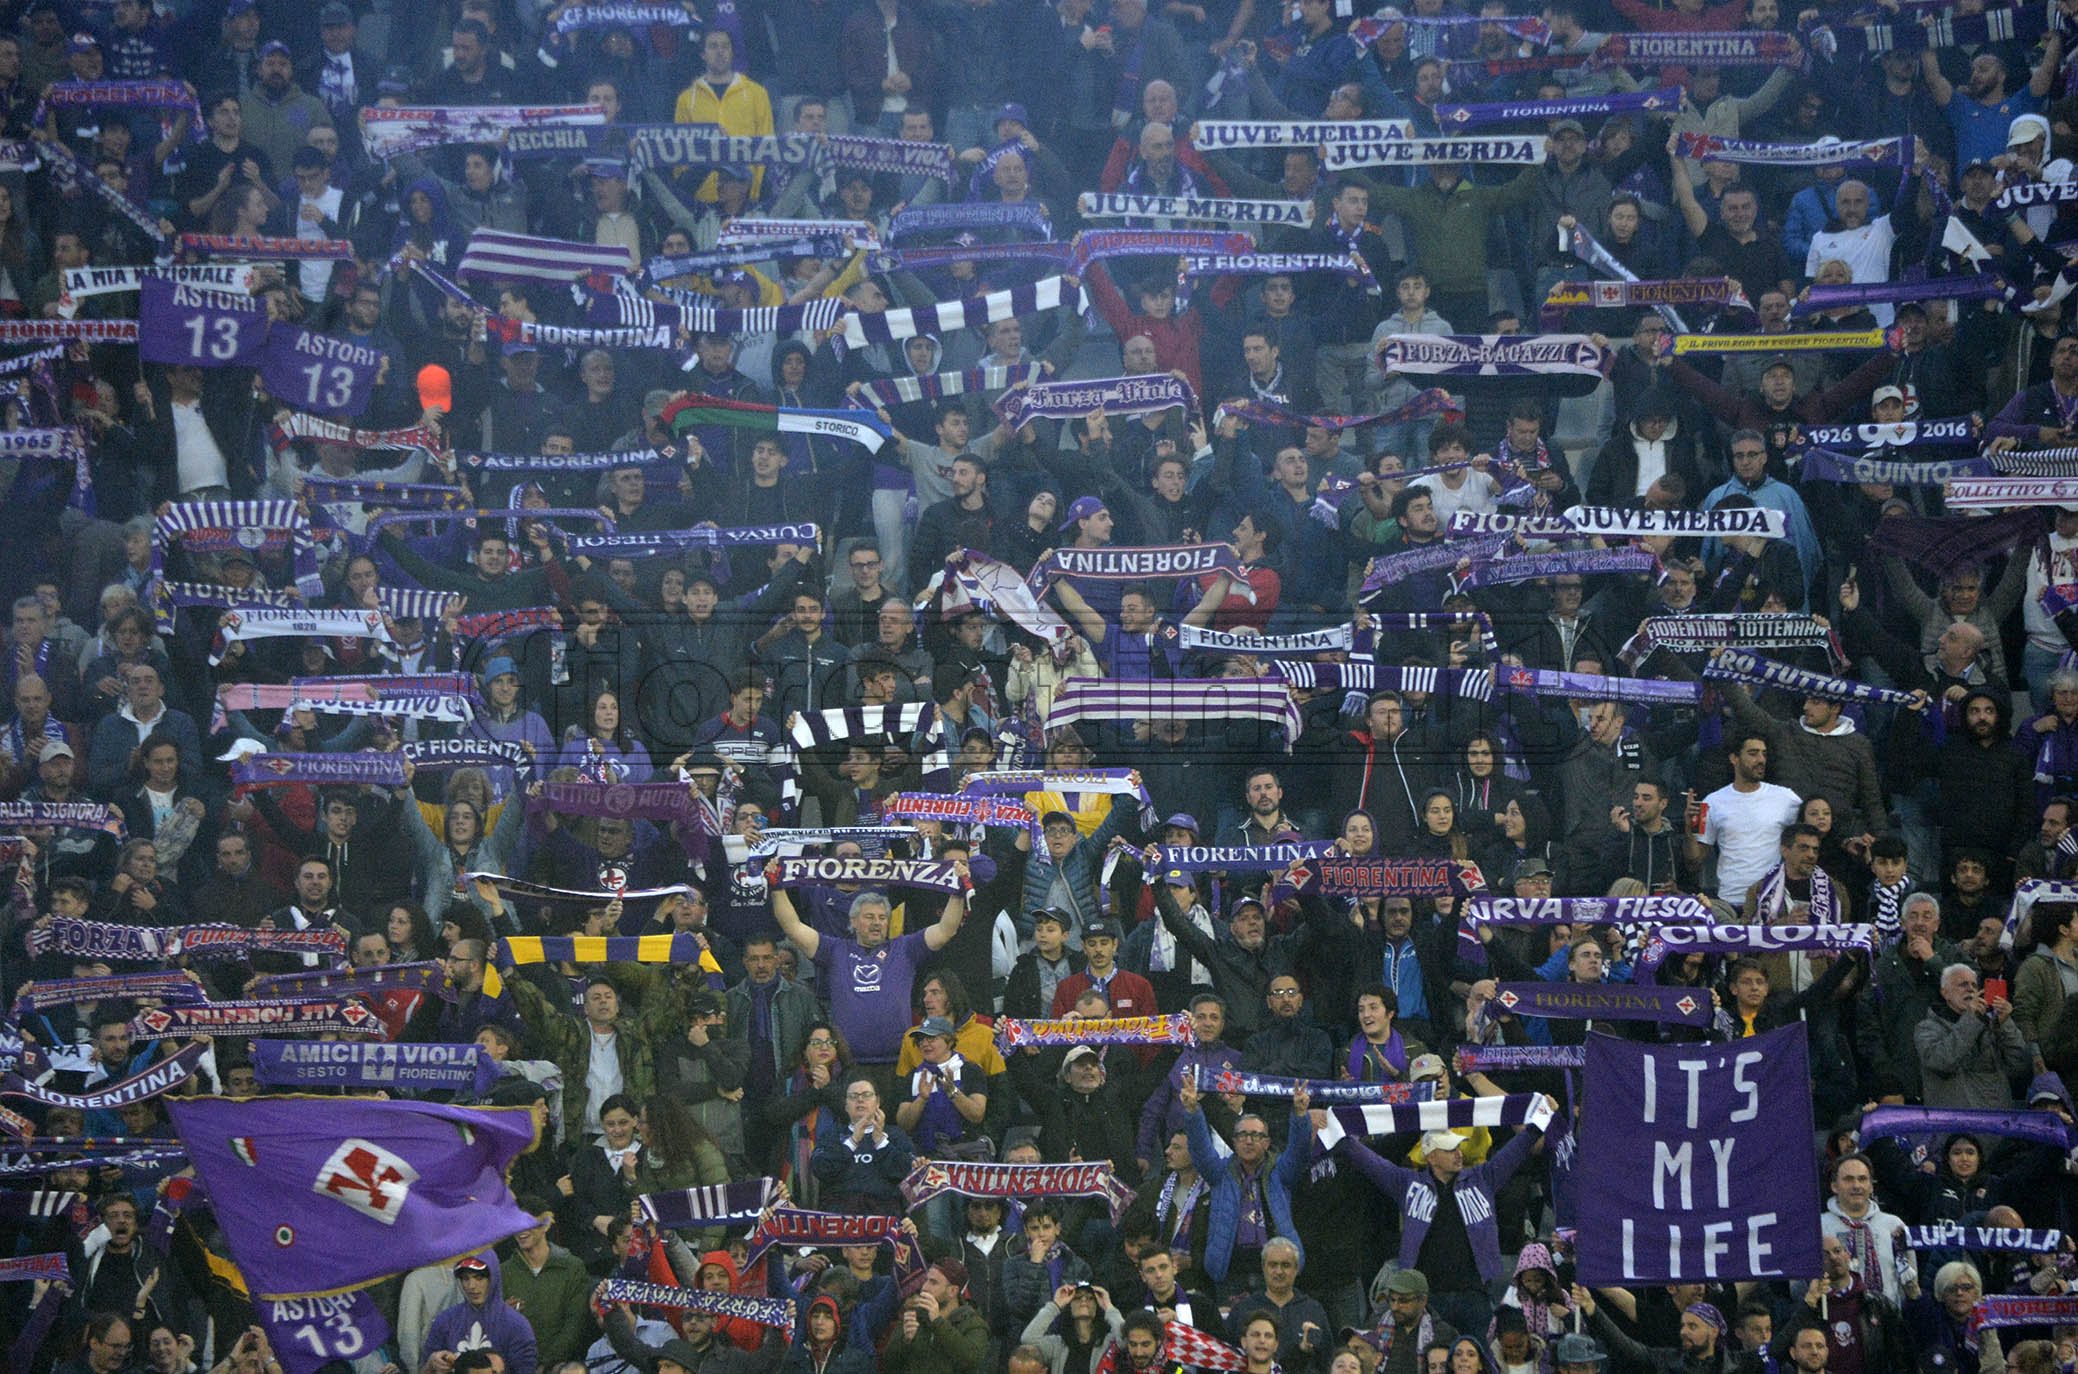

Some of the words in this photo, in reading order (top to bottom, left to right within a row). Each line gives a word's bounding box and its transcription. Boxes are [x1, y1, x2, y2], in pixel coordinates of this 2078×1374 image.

[588, 5, 689, 24] FIORENTINA
[1629, 37, 1756, 58] FIORENTINA
[1502, 102, 1610, 119] FIORENTINA
[1200, 125, 1282, 147] JUVE
[1290, 122, 1403, 147] MERDA
[656, 135, 806, 167] ULTRAS
[1331, 145, 1412, 165] JUVE
[1422, 142, 1534, 162] MERDA
[1997, 181, 2078, 208] JUVE
[1088, 192, 1177, 215] JUVE
[1187, 198, 1305, 221] MERDA
[1214, 253, 1360, 272] FIORENTINA
[92, 272, 127, 288] MIA
[0, 323, 138, 338] FIORENTINA
[184, 314, 239, 360] 13
[521, 323, 672, 349] FIORENTINA
[295, 332, 376, 369] ASTORI
[303, 363, 354, 408] 13
[815, 420, 859, 437] STORICO
[1808, 429, 1853, 444] 1926
[1922, 421, 1966, 438] 2016
[3, 434, 54, 450] 1965
[485, 455, 520, 468] ACF
[527, 449, 658, 468] FIORENTINA
[1853, 460, 1954, 485] QUINTO
[1577, 506, 1656, 531] JUVE
[1661, 506, 1770, 534] MERDA
[1057, 547, 1217, 573] FIORENTINA
[246, 606, 362, 624] FIORENTINA
[1199, 630, 1333, 649] FIORENTINA
[1645, 621, 1728, 639] FIORENTINA
[1764, 661, 1848, 696] TUTTO
[716, 747, 766, 759] OPEL
[298, 760, 402, 777] FIORENTINA
[983, 772, 1107, 787] FIORENTINA
[0, 803, 34, 819] ALLA
[1167, 844, 1318, 864] FIORENTINA
[783, 857, 959, 892] FIORENZA
[1320, 866, 1449, 888] FIORENTINA
[1535, 993, 1662, 1011] FIORENTINA
[173, 1006, 295, 1025] FIORENTINA
[280, 1044, 360, 1065] AMICI
[402, 1045, 478, 1067] VIOLA
[24, 1059, 186, 1109] FIORENTINA
[296, 1067, 347, 1078] SESTO
[400, 1067, 476, 1081] FIORENTINO
[1643, 1052, 1763, 1129] IT'S
[854, 1153, 874, 1165] YO
[1652, 1137, 1736, 1210] MY
[1622, 1212, 1783, 1279] LIFE
[1906, 1226, 1966, 1248] LUPI
[1975, 1228, 2062, 1252] VIOLA
[294, 1314, 364, 1358] 13
